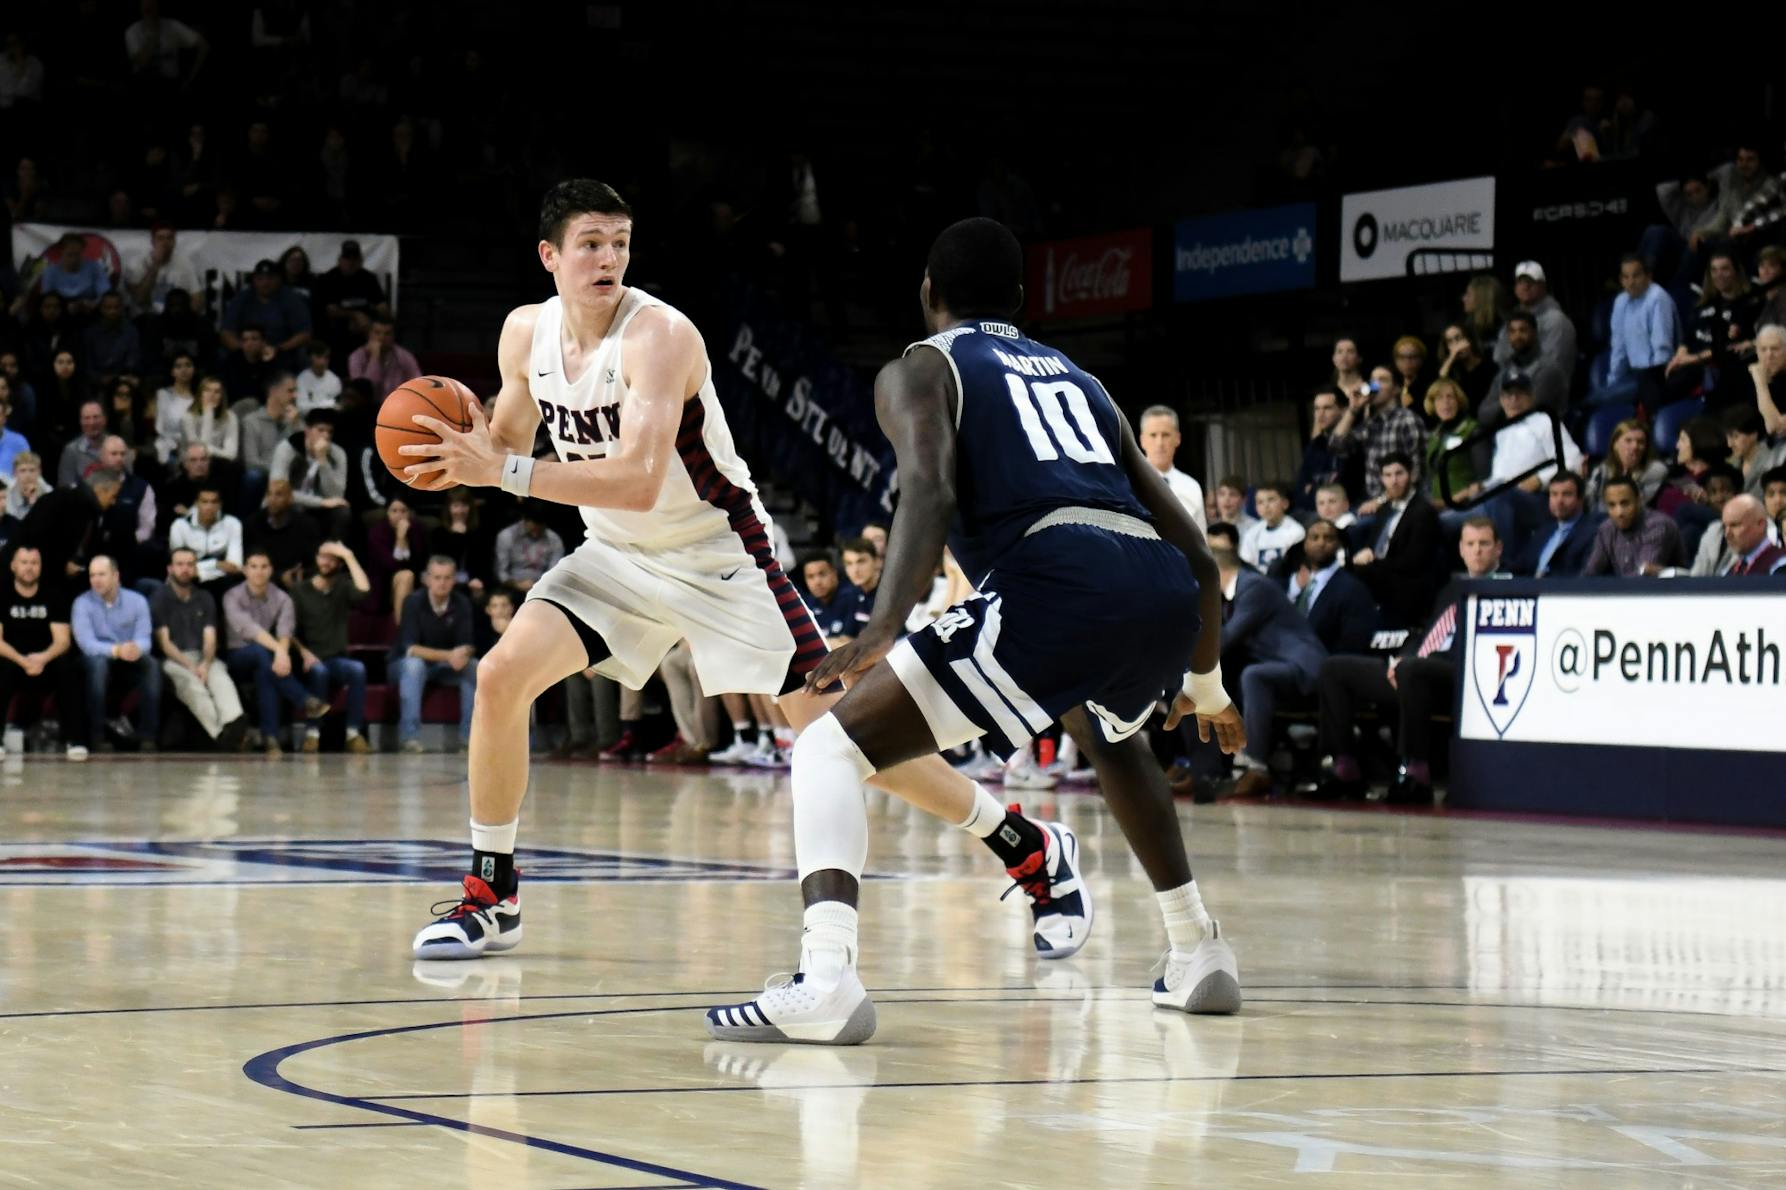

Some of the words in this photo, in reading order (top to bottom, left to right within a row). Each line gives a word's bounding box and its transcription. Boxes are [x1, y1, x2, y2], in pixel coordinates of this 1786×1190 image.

[1384, 213, 1481, 242] MACQUARIE
[1176, 236, 1288, 274] Independence
[980, 322, 1018, 339] OWLS
[538, 398, 620, 445] PENN
[1005, 373, 1116, 465] 10
[1479, 599, 1535, 627] PENN
